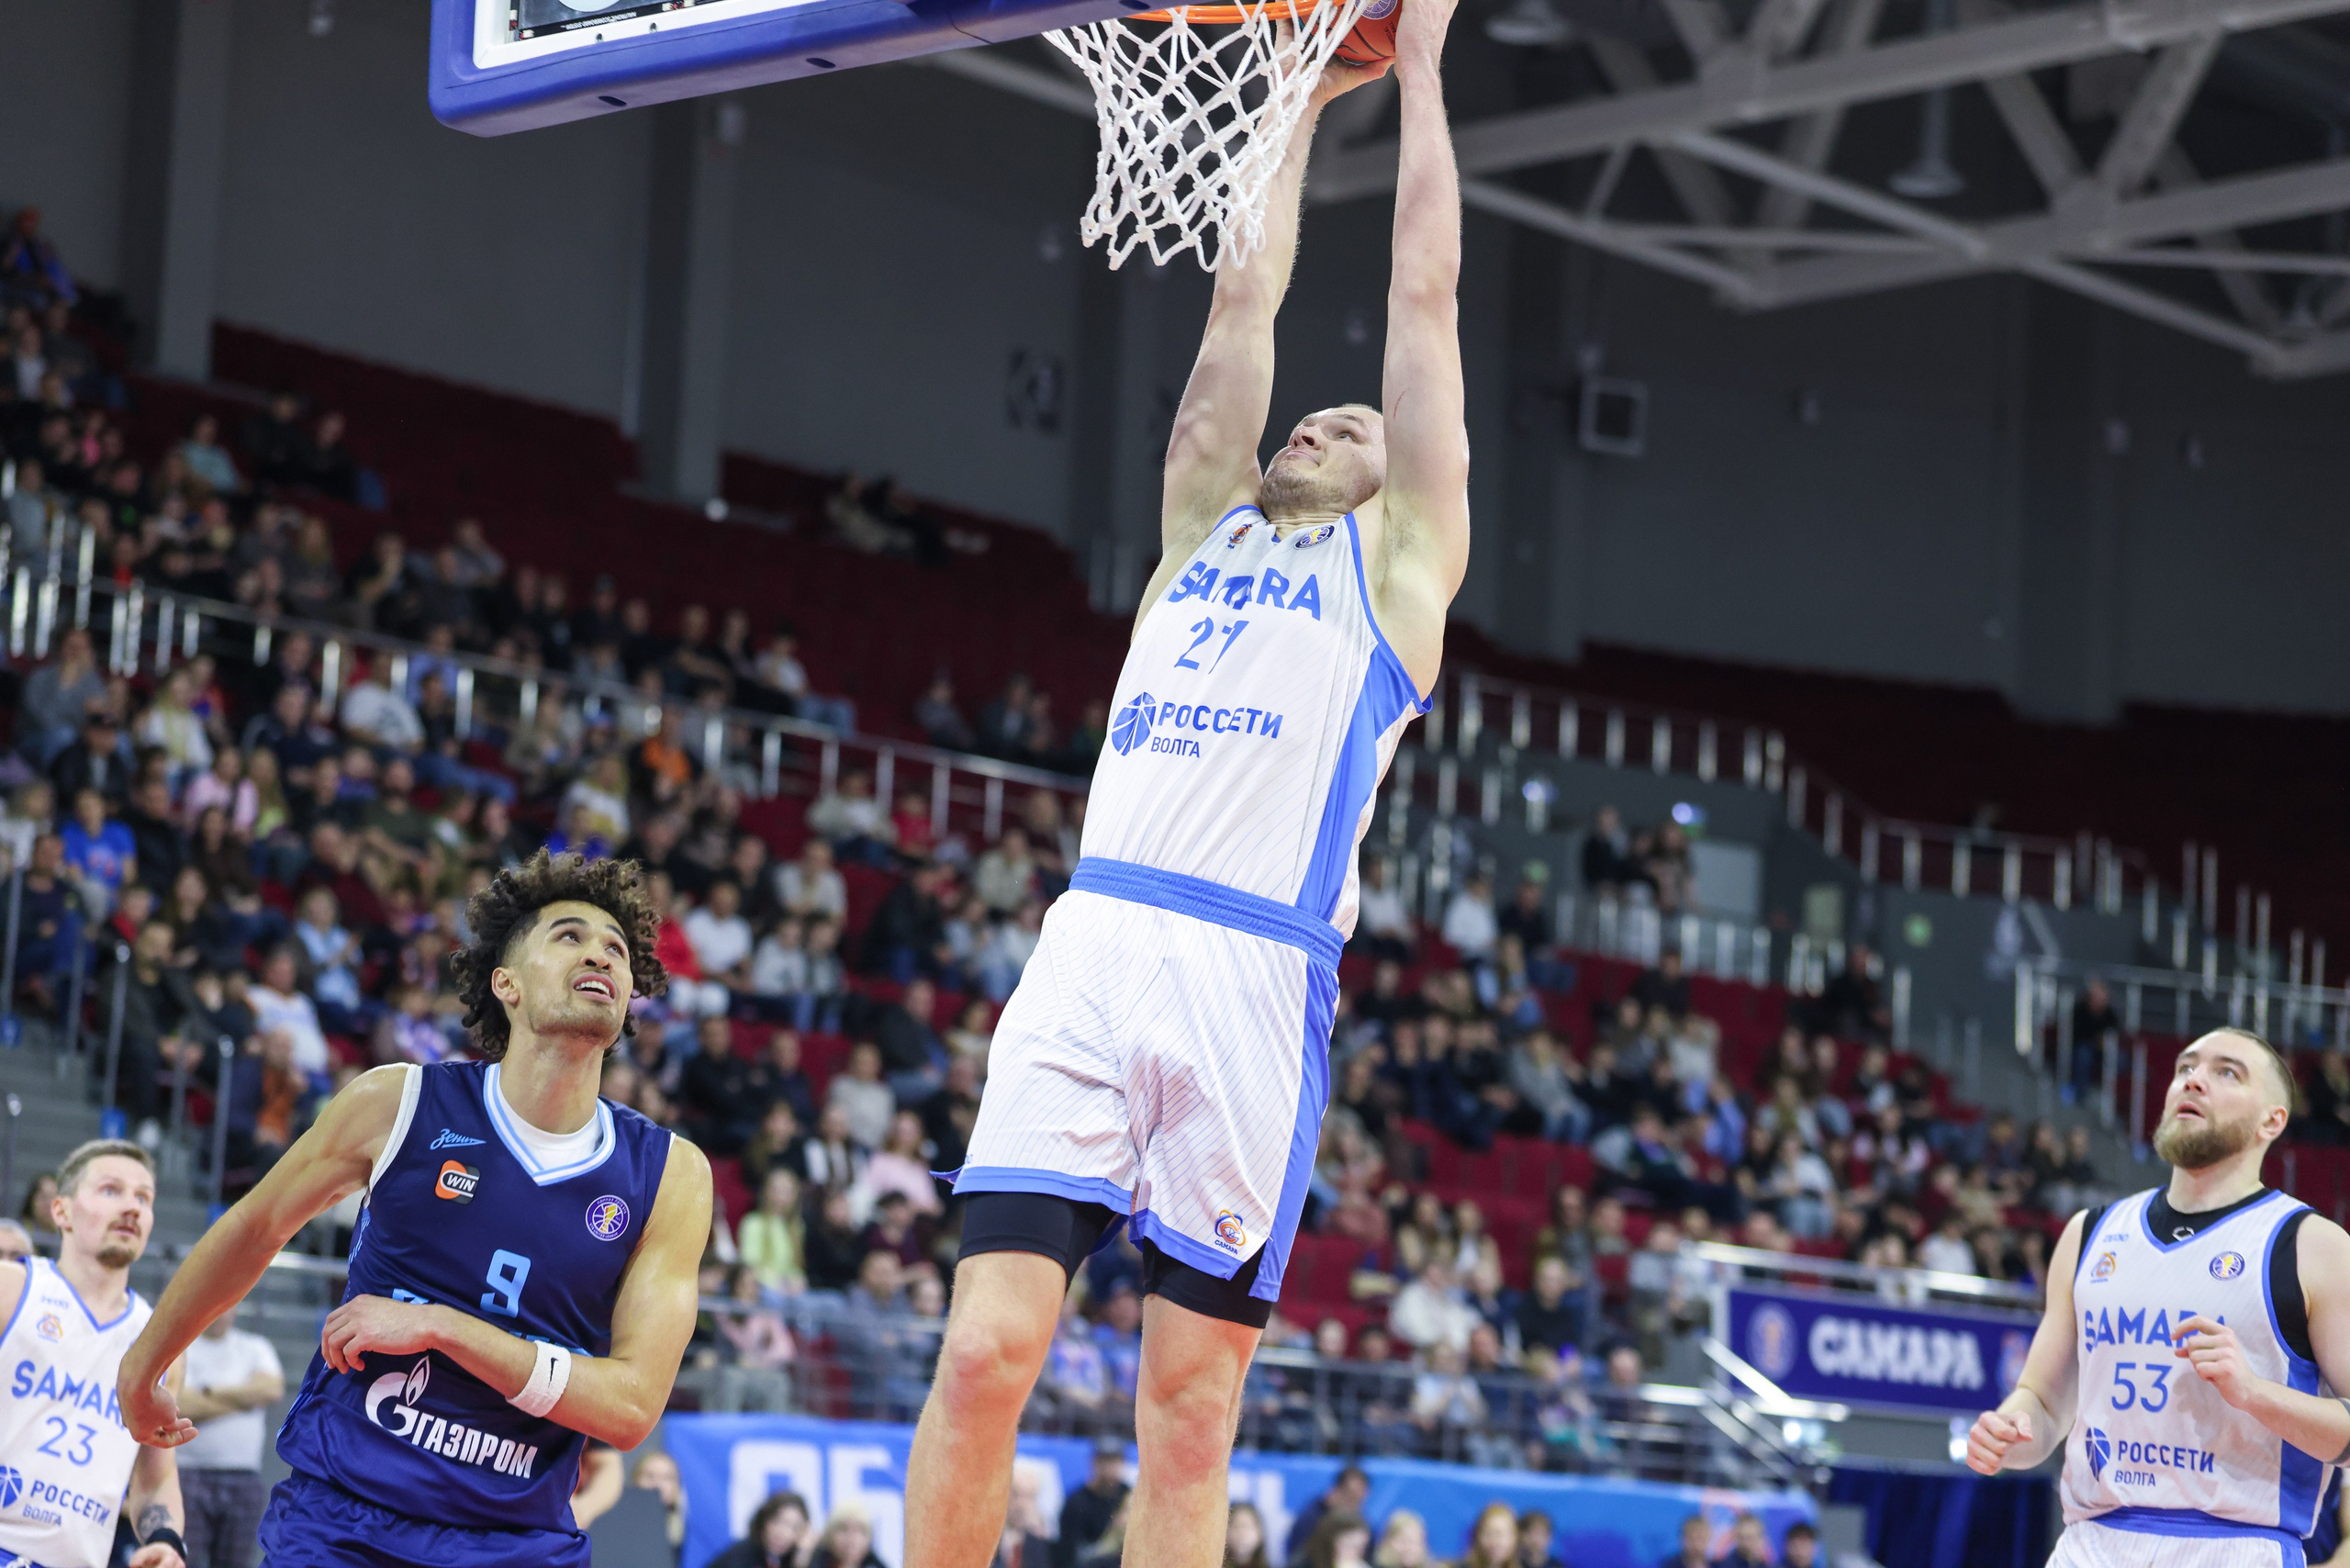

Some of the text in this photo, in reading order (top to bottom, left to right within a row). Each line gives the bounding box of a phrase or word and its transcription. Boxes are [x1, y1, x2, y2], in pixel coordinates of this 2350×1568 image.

[1158, 701, 1283, 739] РОССЕТИ
[1150, 736, 1201, 758] ВОЛГА
[446, 1173, 476, 1193] WIN
[480, 1249, 532, 1318] 9
[1808, 1315, 1986, 1391] САМАРА
[2085, 1306, 2226, 1353] SAMAR
[11, 1360, 125, 1430] SAMAR
[2111, 1362, 2173, 1413] 53
[37, 1417, 98, 1466] 23
[411, 1412, 538, 1479] ГАЗПРОМ
[2118, 1440, 2214, 1473] РОССЕТИ
[2114, 1471, 2156, 1486] ВОЛГА
[22, 1504, 62, 1527] ВОЛГА
[30, 1480, 111, 1527] РОССЕТИ
